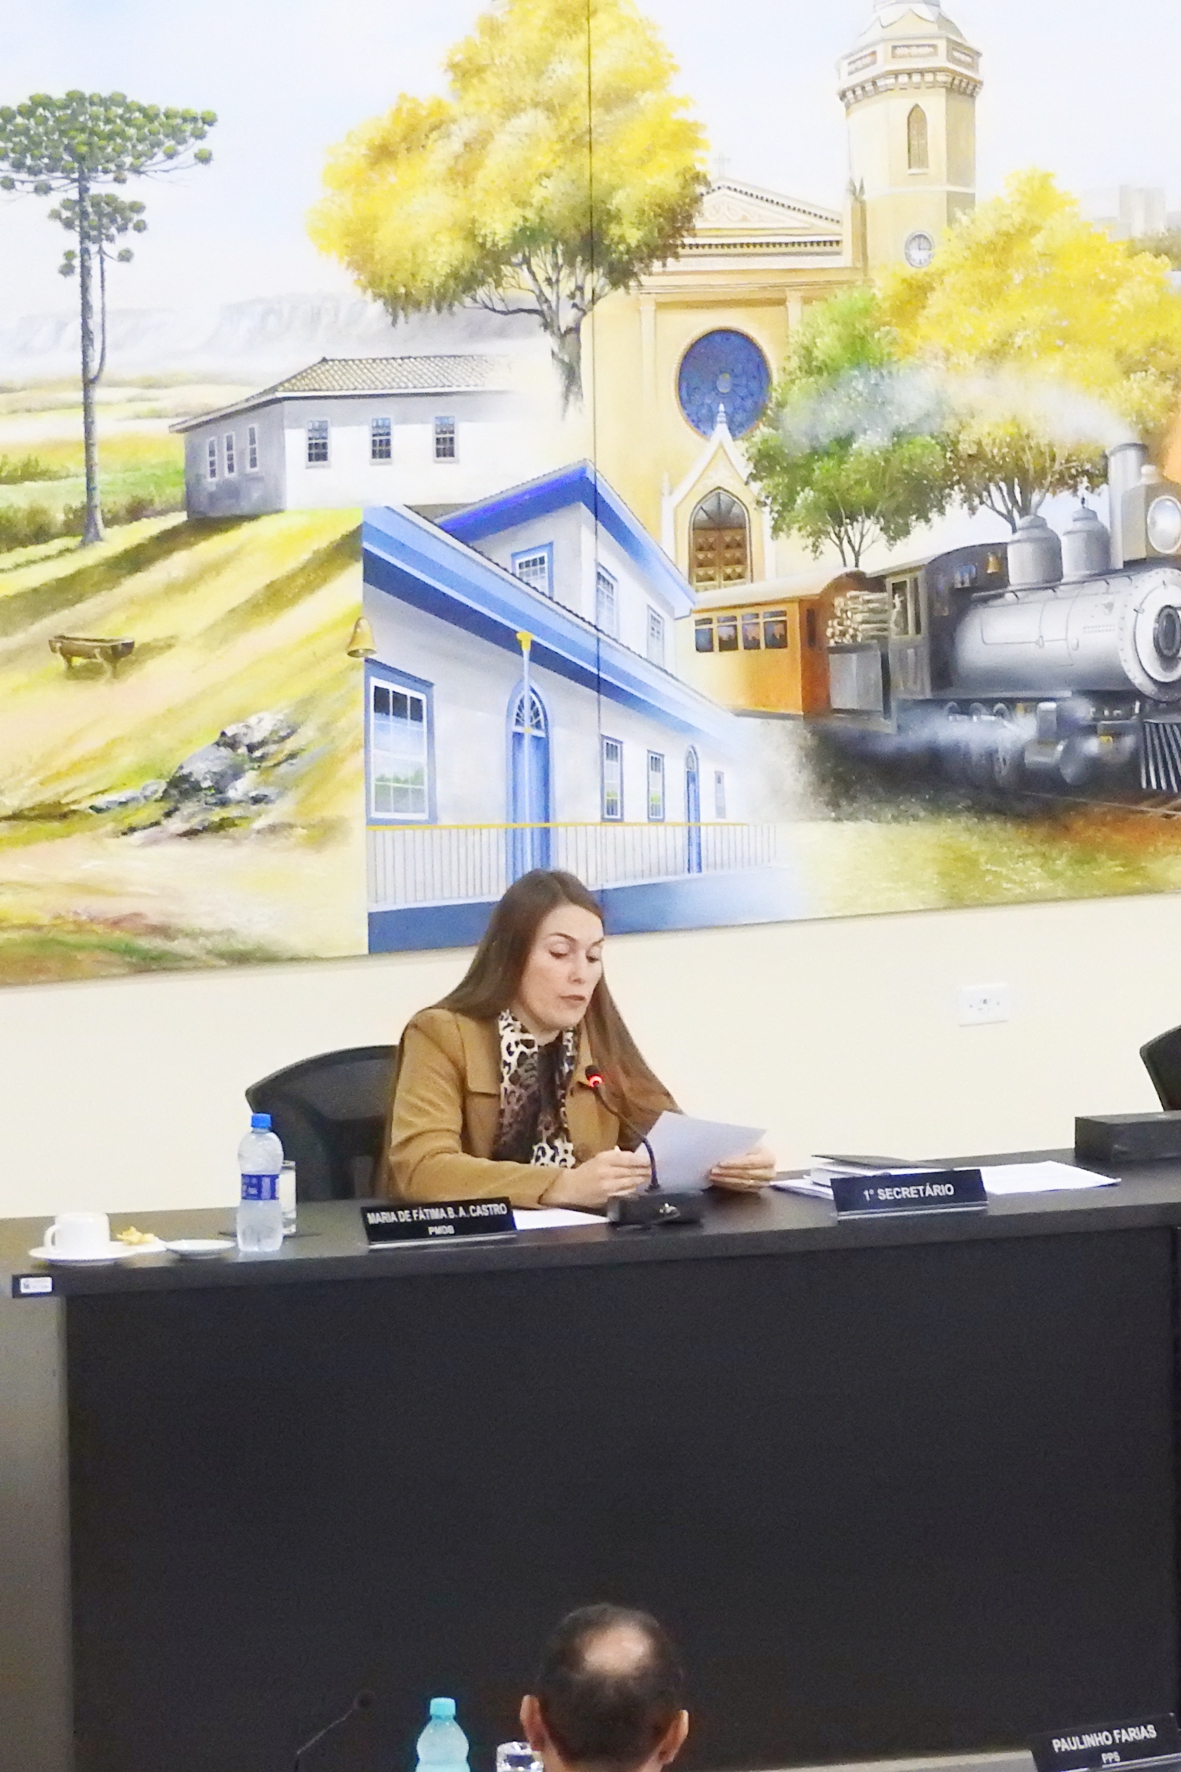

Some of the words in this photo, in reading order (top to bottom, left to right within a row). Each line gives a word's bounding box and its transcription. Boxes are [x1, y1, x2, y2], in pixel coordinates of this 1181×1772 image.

[877, 1182, 955, 1200] SECRETÁRIO
[367, 1211, 398, 1225] MARIA
[397, 1210, 412, 1222] DE
[412, 1206, 448, 1221] FÁTIMA
[469, 1203, 508, 1217] CASTRO
[1052, 1731, 1113, 1753] PAULINHO
[1113, 1724, 1158, 1743] FARIAS
[1101, 1751, 1121, 1764] PPS
